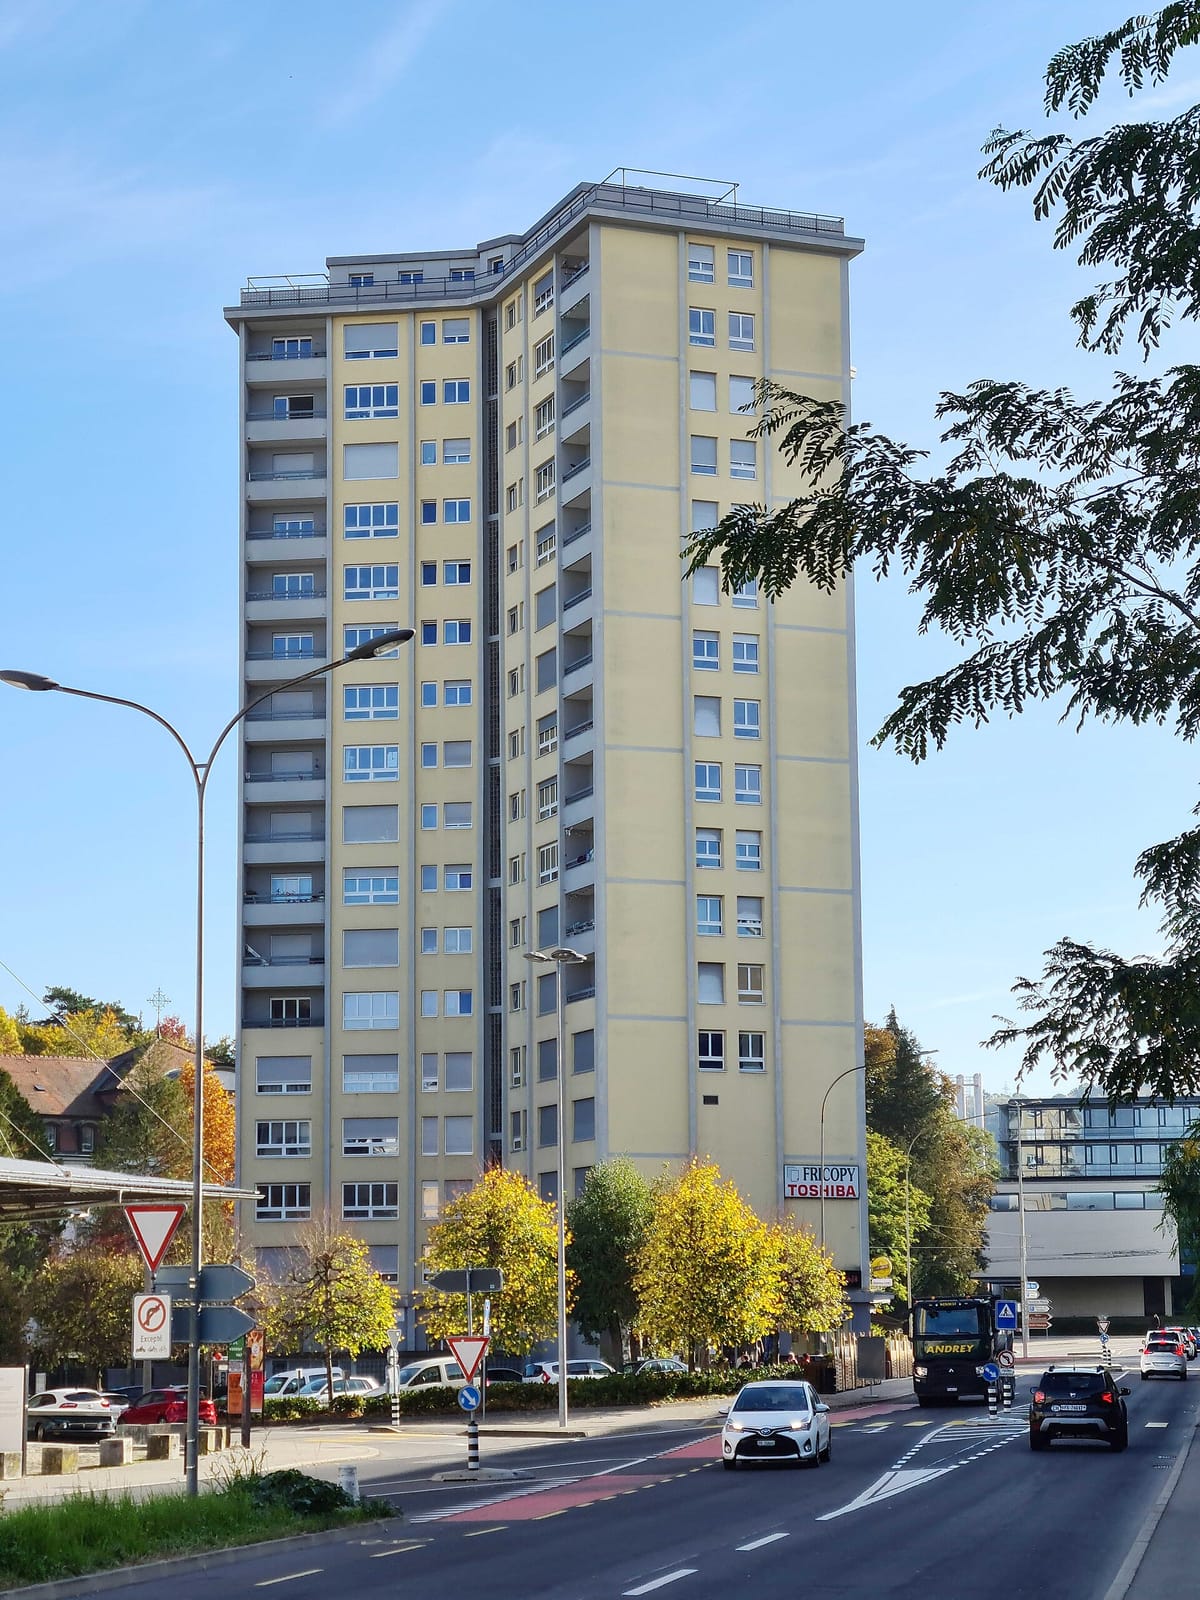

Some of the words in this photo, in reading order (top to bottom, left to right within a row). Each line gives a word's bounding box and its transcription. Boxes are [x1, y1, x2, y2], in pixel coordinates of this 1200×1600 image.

[803, 1167, 856, 1182] FRICOPY
[787, 1184, 857, 1197] TOSHIBA
[926, 1344, 975, 1354] ANDREY
